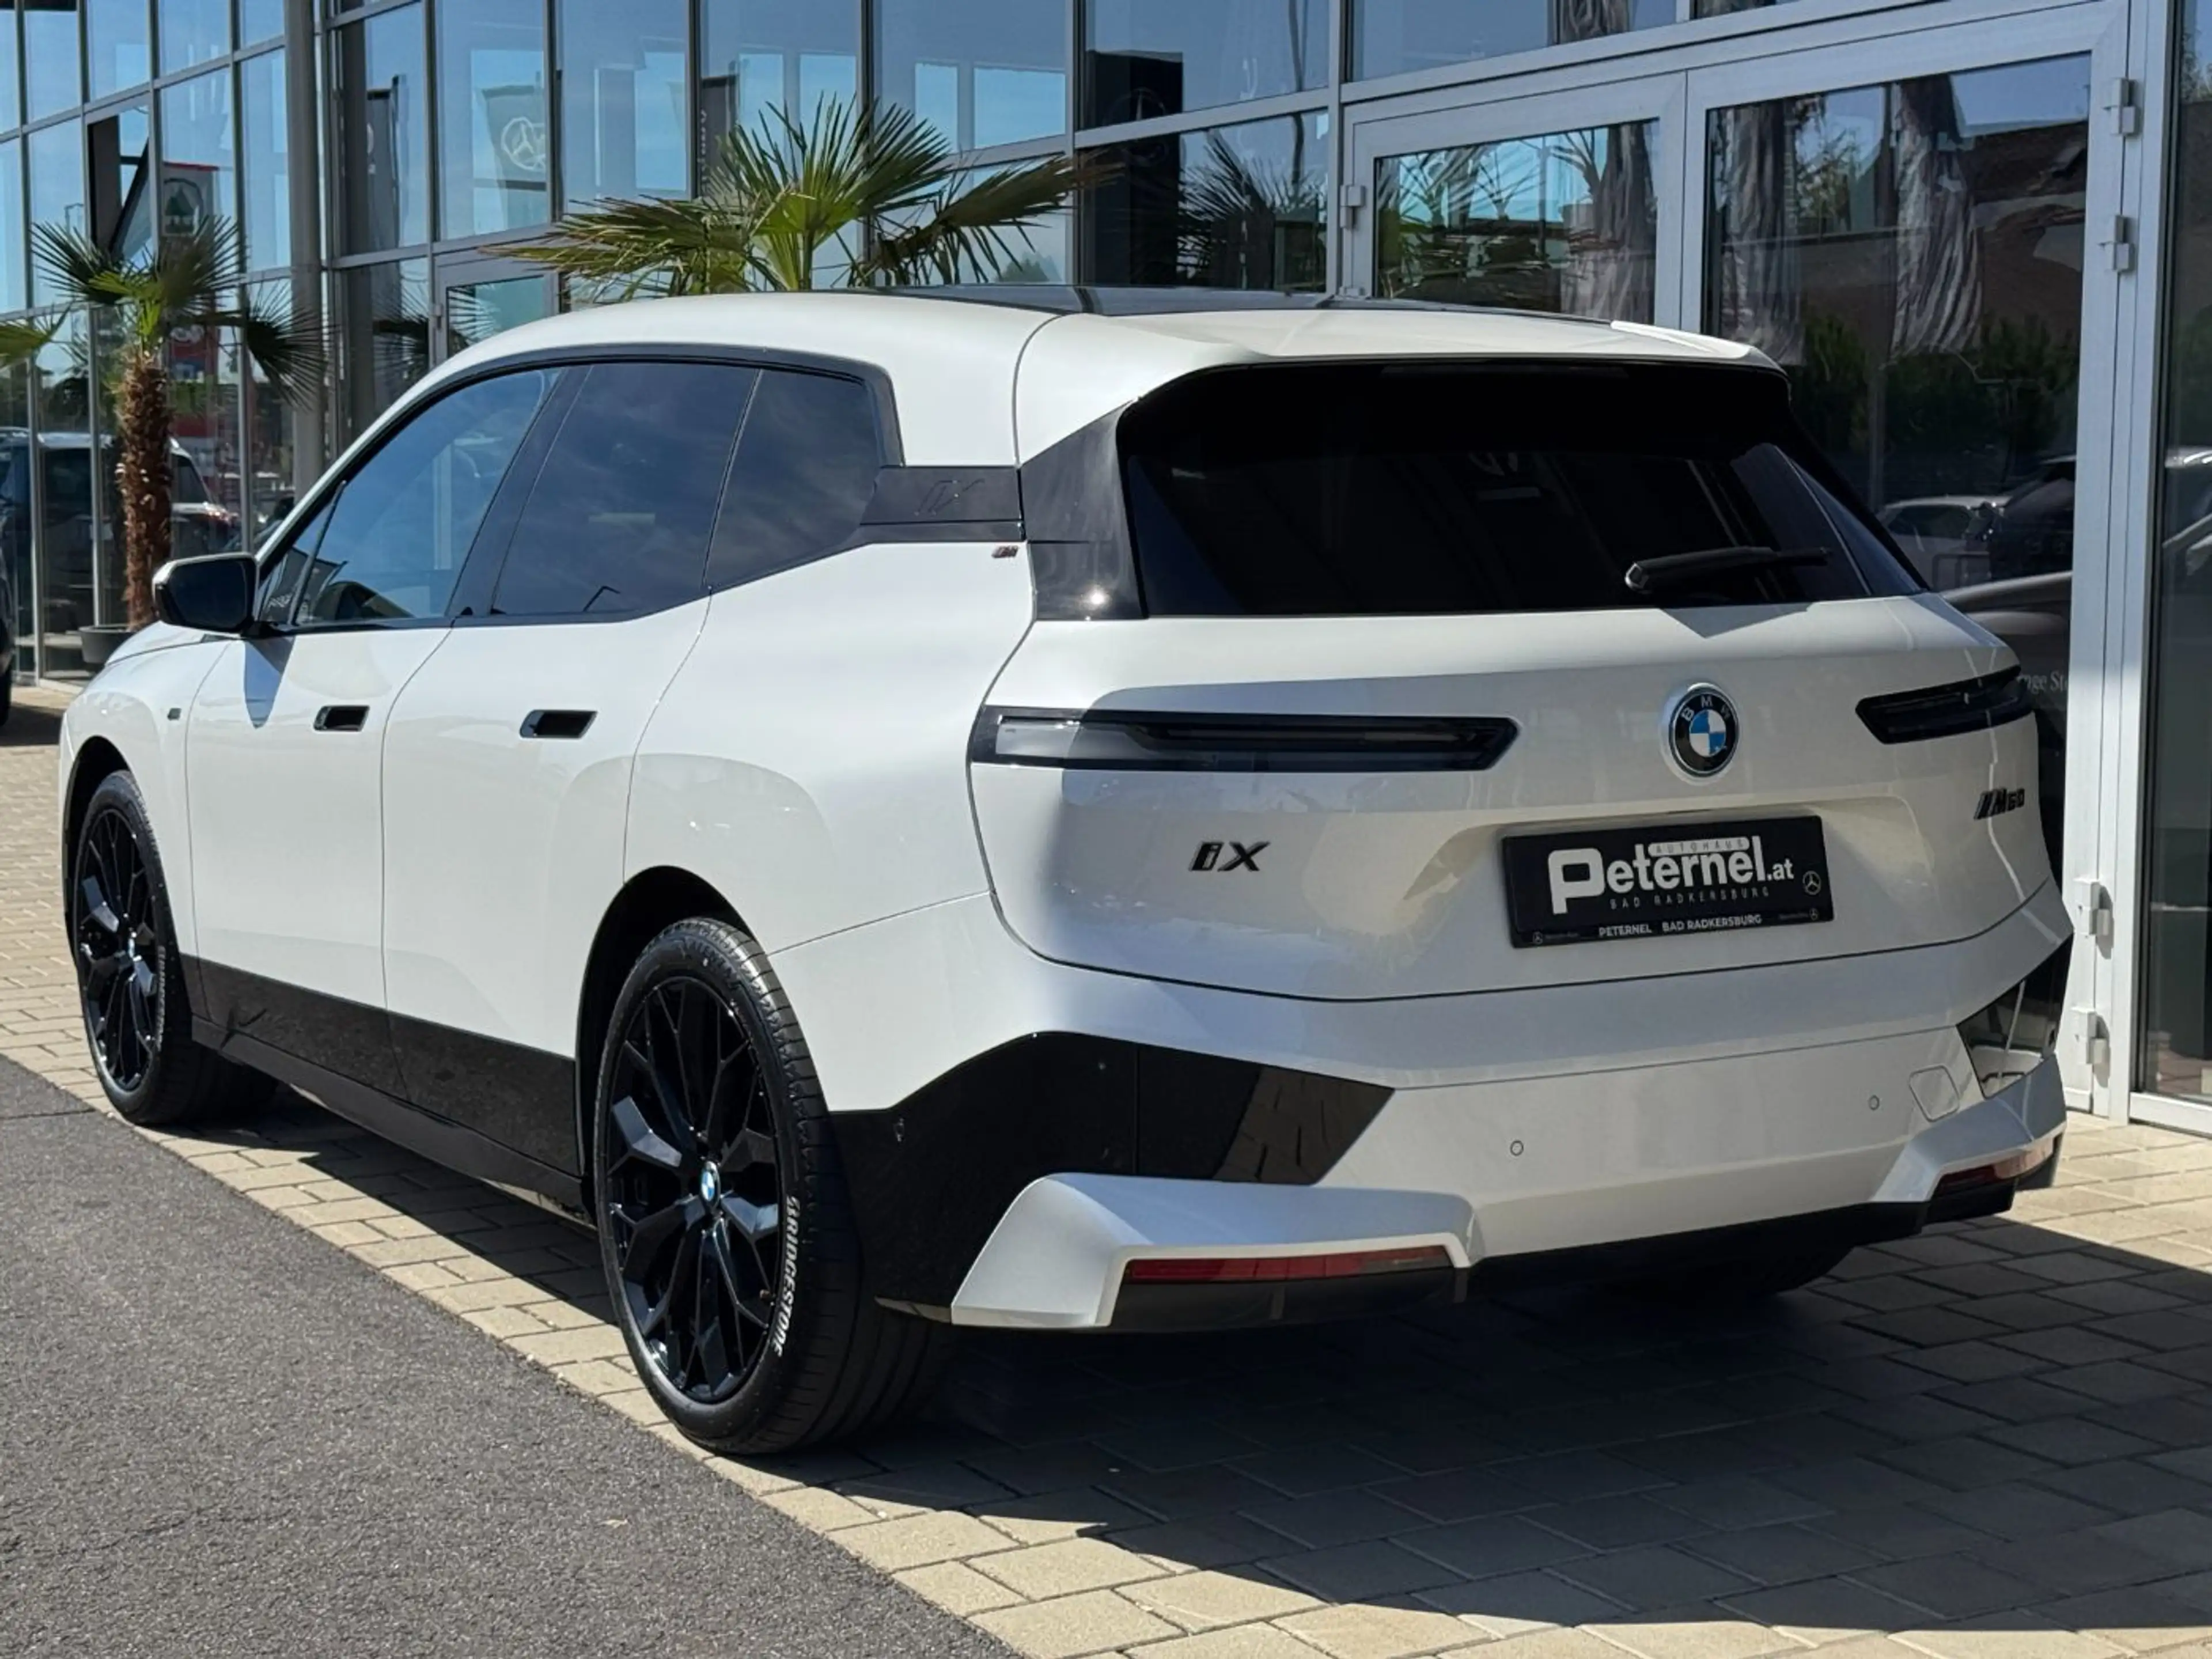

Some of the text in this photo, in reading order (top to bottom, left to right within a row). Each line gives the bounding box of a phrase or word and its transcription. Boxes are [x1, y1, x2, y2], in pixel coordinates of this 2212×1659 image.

[1680, 695, 1732, 722] BMW
[1189, 841, 1271, 872] iX
[1655, 838, 1744, 854] AUTOHAUS
[1609, 887, 1770, 910] BAD RADKERSBURG
[1599, 922, 1653, 937] PETERNEL
[1662, 919, 1685, 933] BAD
[1686, 914, 1763, 930] RADKERSBURG
[773, 1195, 800, 1358] BRIDGESTONE
